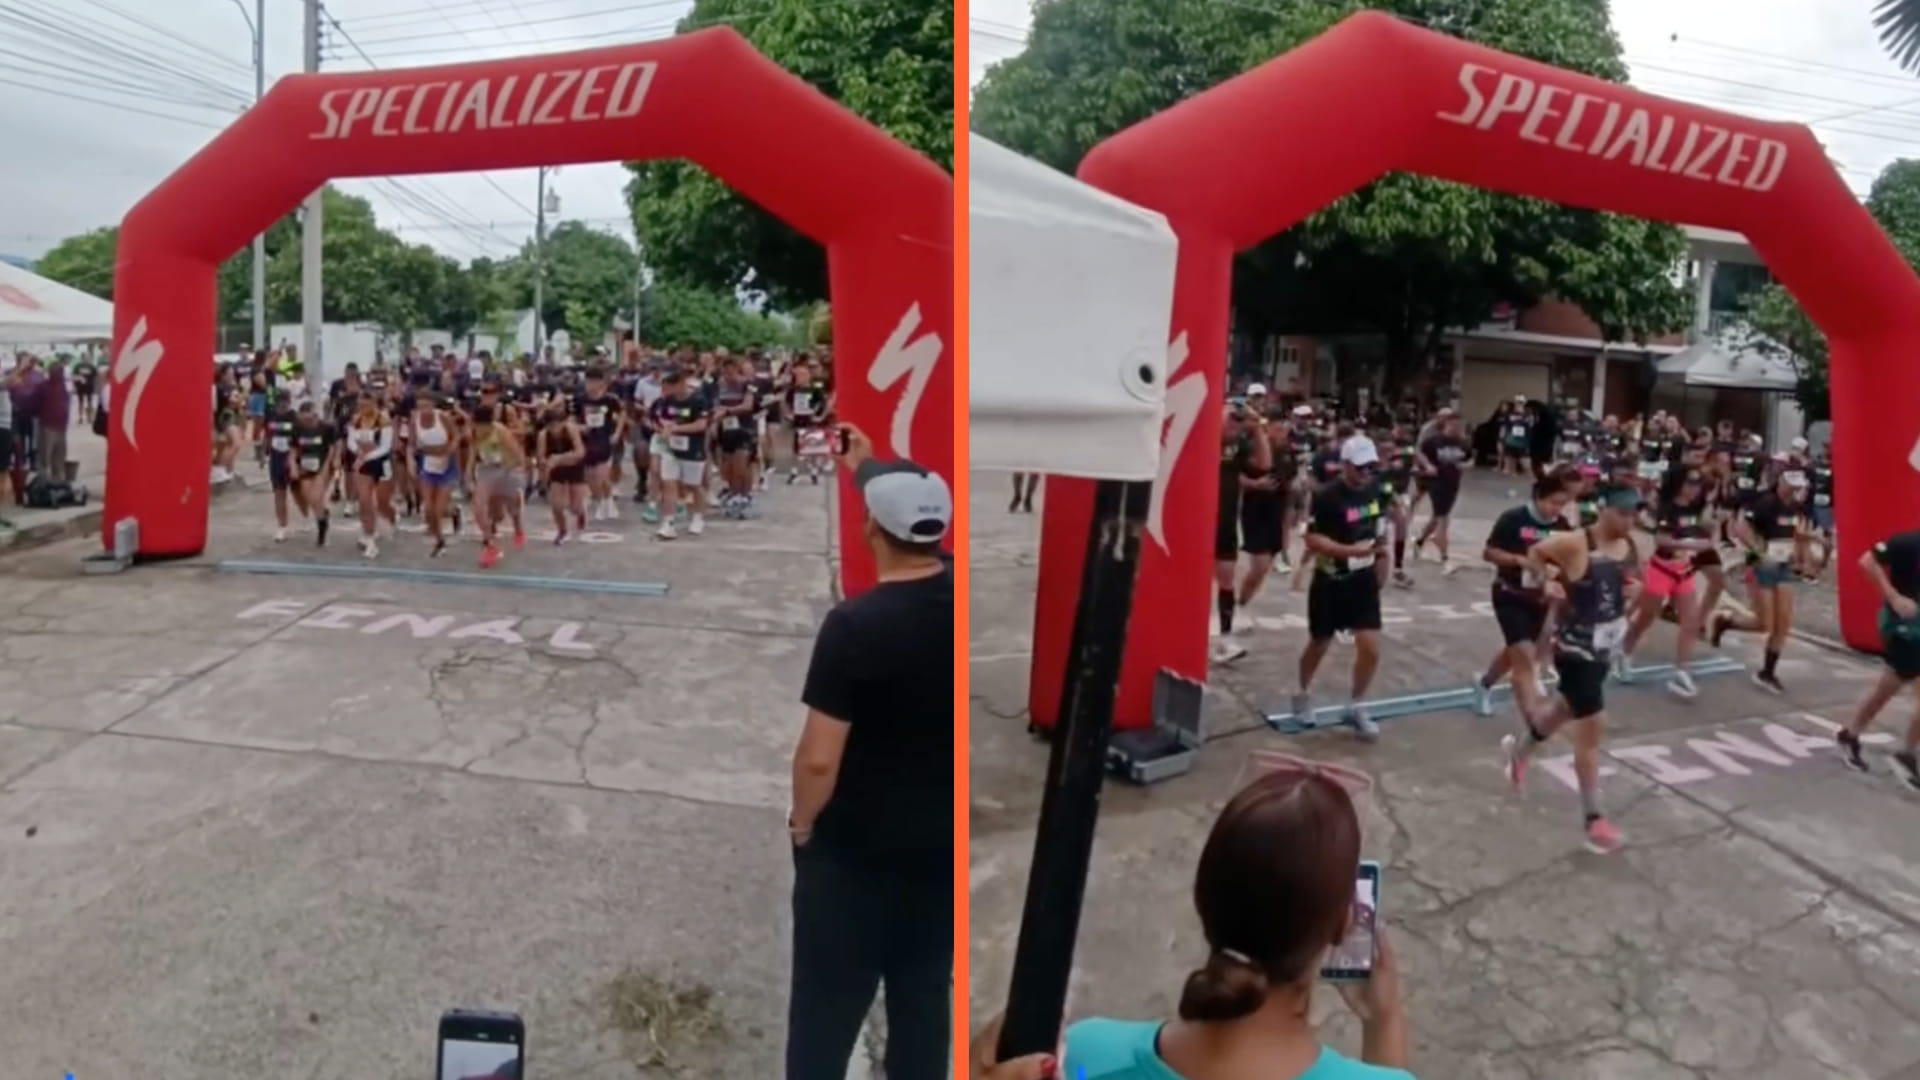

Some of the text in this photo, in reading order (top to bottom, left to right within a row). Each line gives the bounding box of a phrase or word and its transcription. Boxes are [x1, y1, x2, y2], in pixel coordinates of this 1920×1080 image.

[308, 61, 658, 139] SPECIALIZED
[1436, 62, 1788, 192] SPECIALIZED
[236, 600, 597, 651] FINAL
